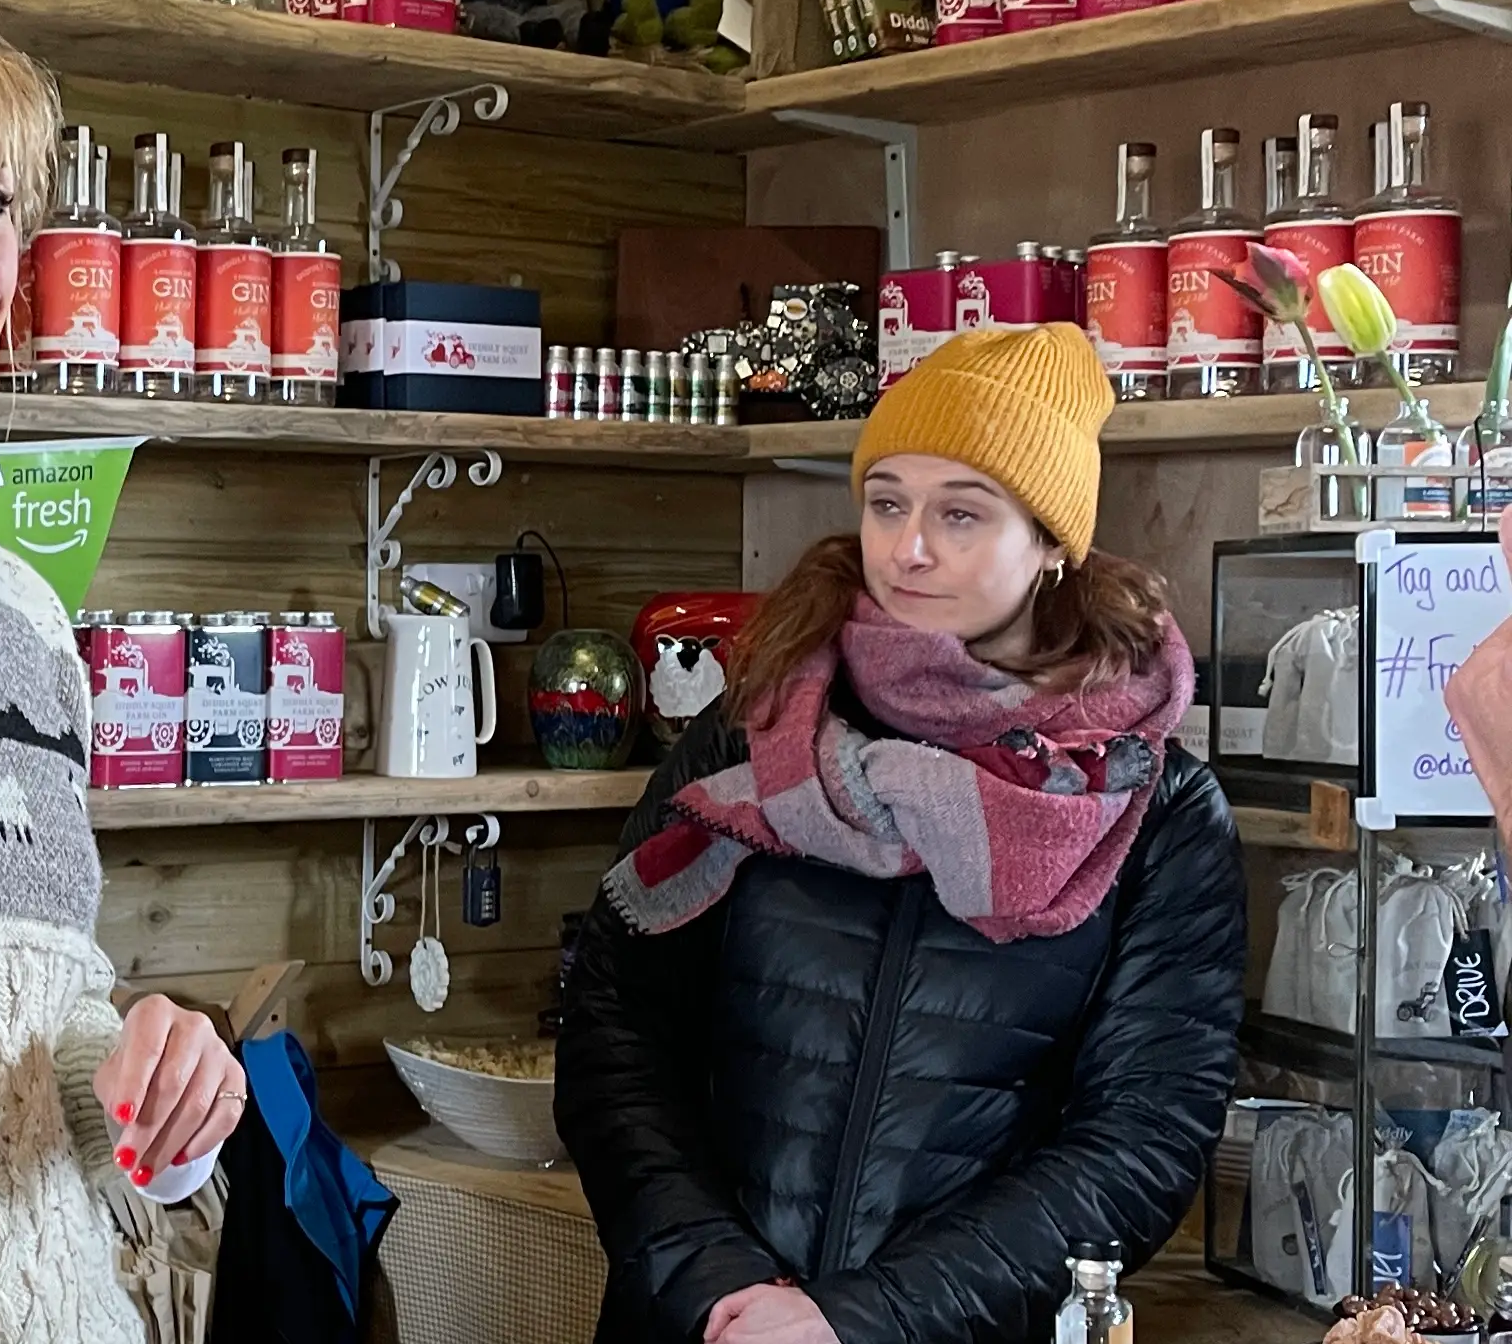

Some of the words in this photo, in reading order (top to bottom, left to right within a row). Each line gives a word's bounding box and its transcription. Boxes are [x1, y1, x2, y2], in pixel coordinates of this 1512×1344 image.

[889, 12, 935, 33] Diddl
[1357, 251, 1405, 276] GIN
[68, 266, 114, 289] GIN
[152, 277, 193, 299] GIN
[1168, 270, 1211, 294] GIN
[231, 282, 270, 304] GIN
[11, 463, 94, 485] amazon
[12, 488, 91, 530] fresh
[1384, 551, 1436, 612] Tag
[1445, 554, 1502, 594] and
[1453, 951, 1490, 1025] DRIVE
